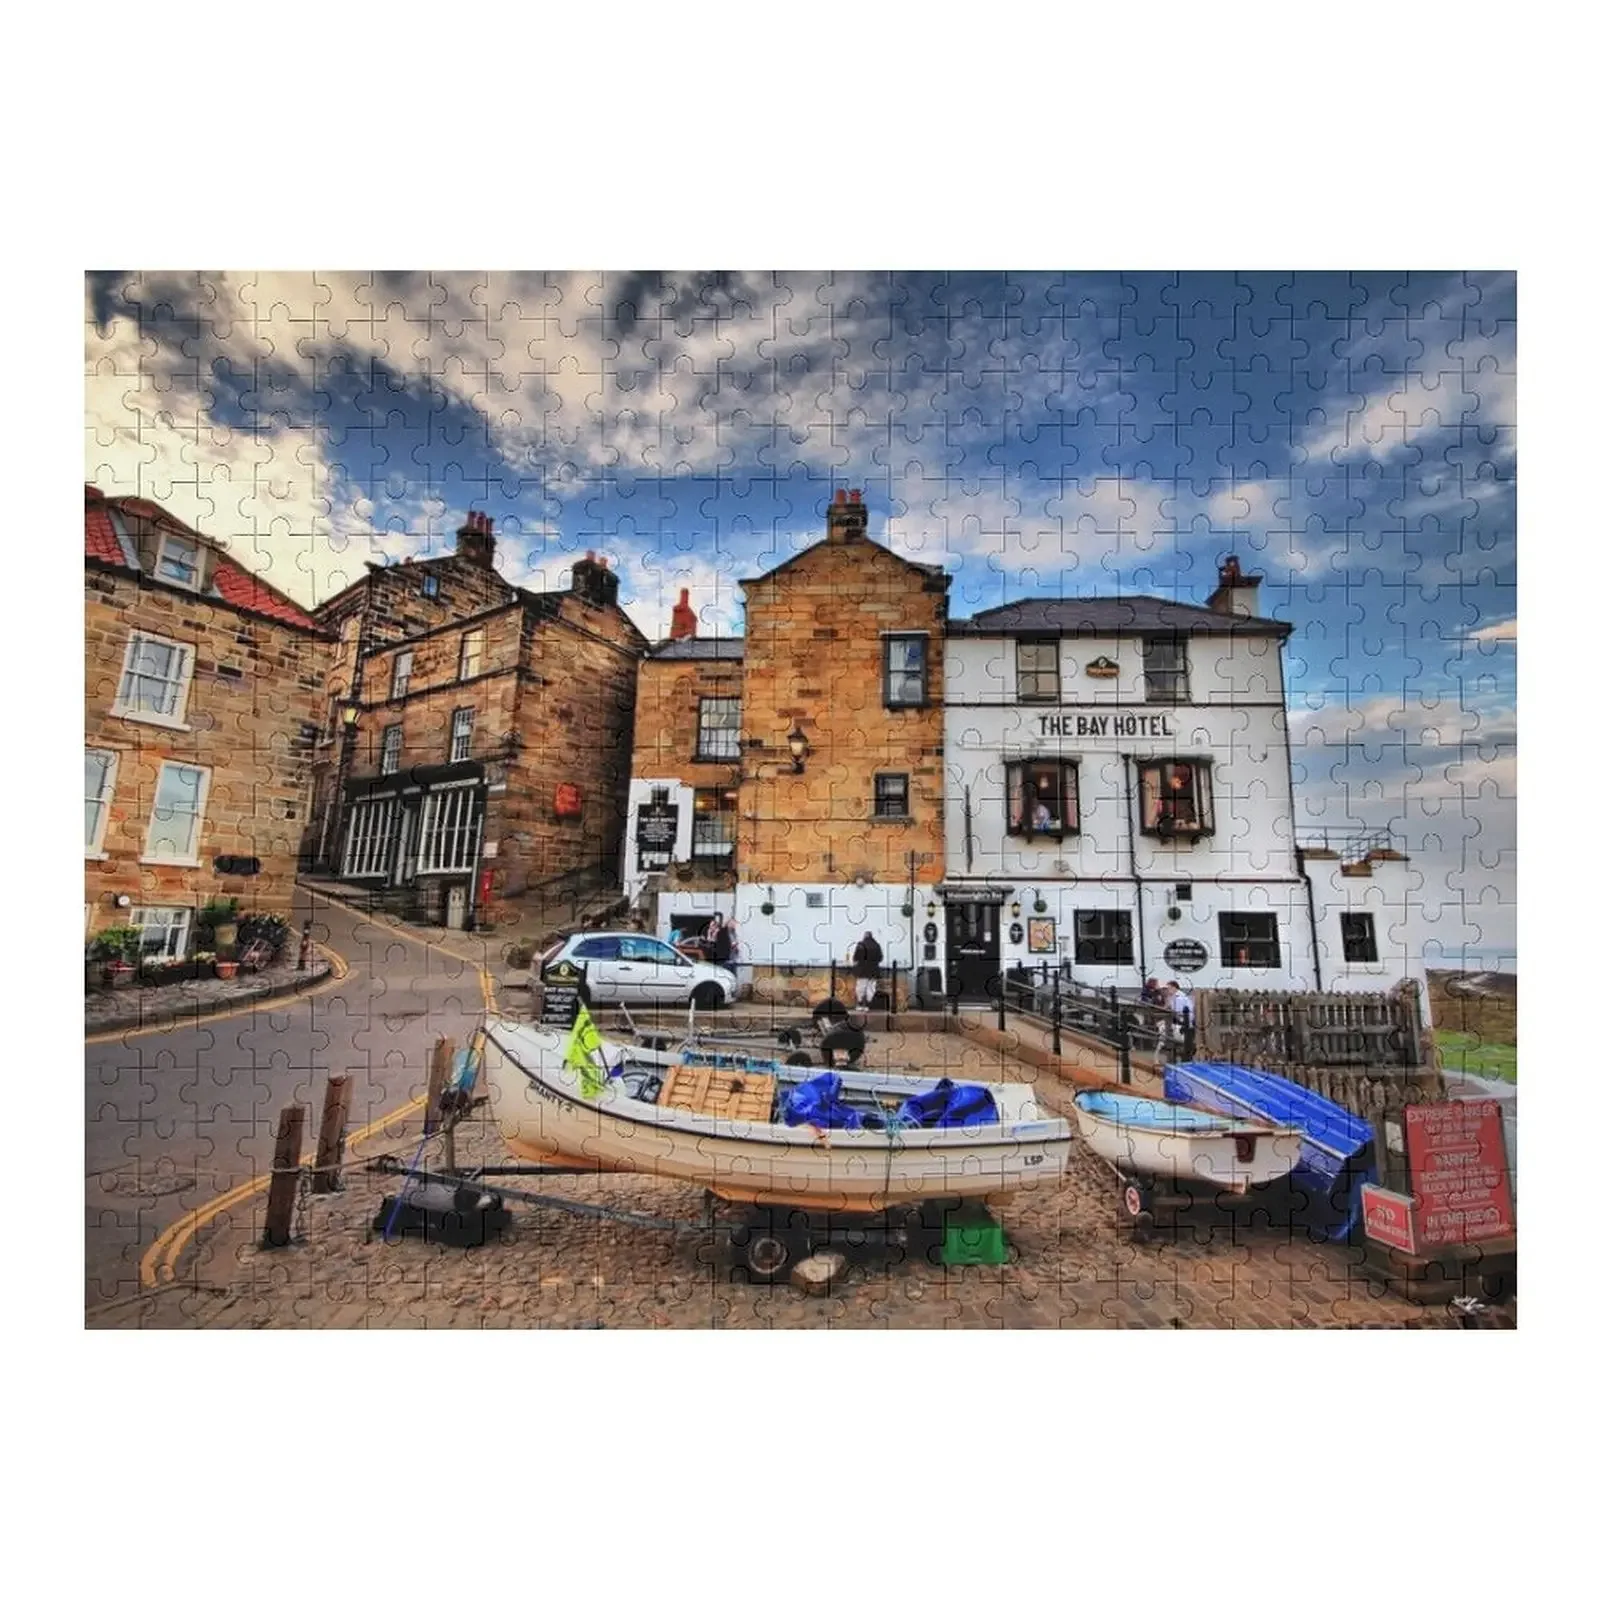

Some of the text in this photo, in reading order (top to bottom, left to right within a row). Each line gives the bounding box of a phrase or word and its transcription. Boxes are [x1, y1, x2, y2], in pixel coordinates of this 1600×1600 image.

[1038, 715, 1173, 736] THE BAY HOTEL
